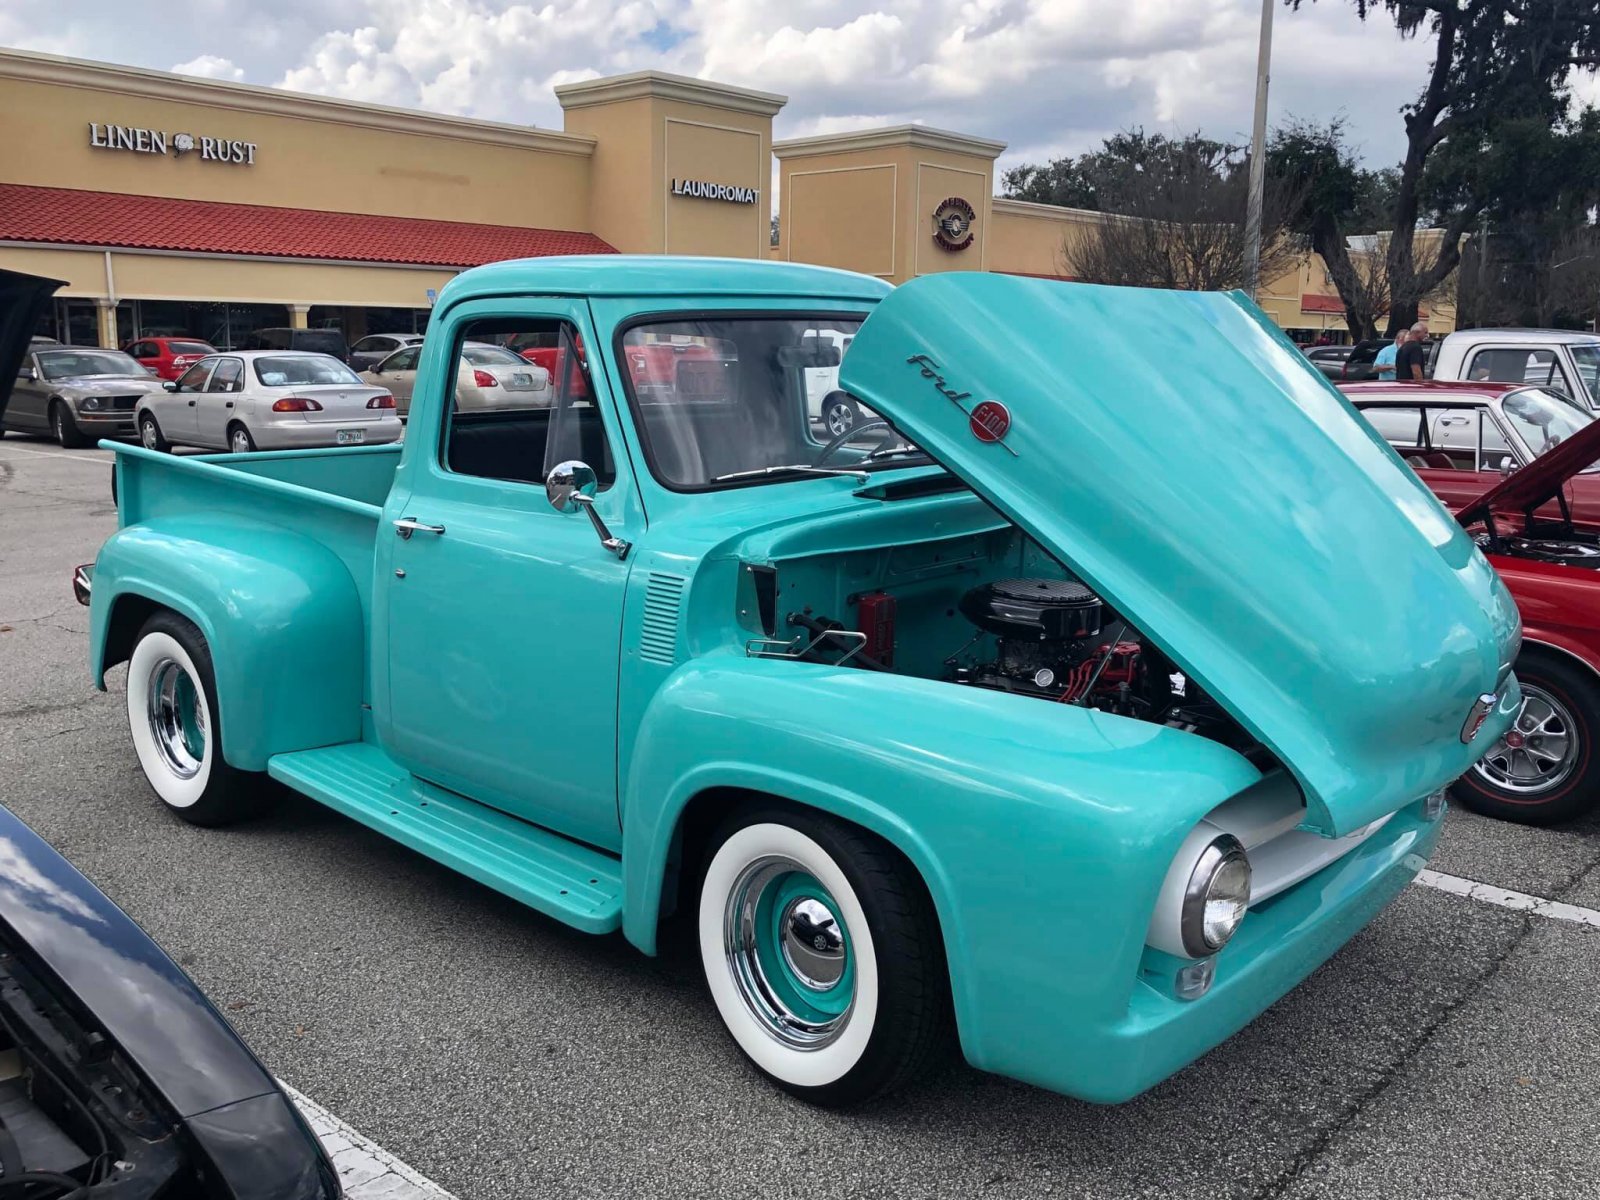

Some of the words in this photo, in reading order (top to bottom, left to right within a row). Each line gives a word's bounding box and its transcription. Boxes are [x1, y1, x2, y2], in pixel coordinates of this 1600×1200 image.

[89, 122, 167, 154] LINEN
[200, 136, 257, 164] RUST
[672, 179, 760, 204] LAUNDROMAT
[906, 355, 972, 401] Ford
